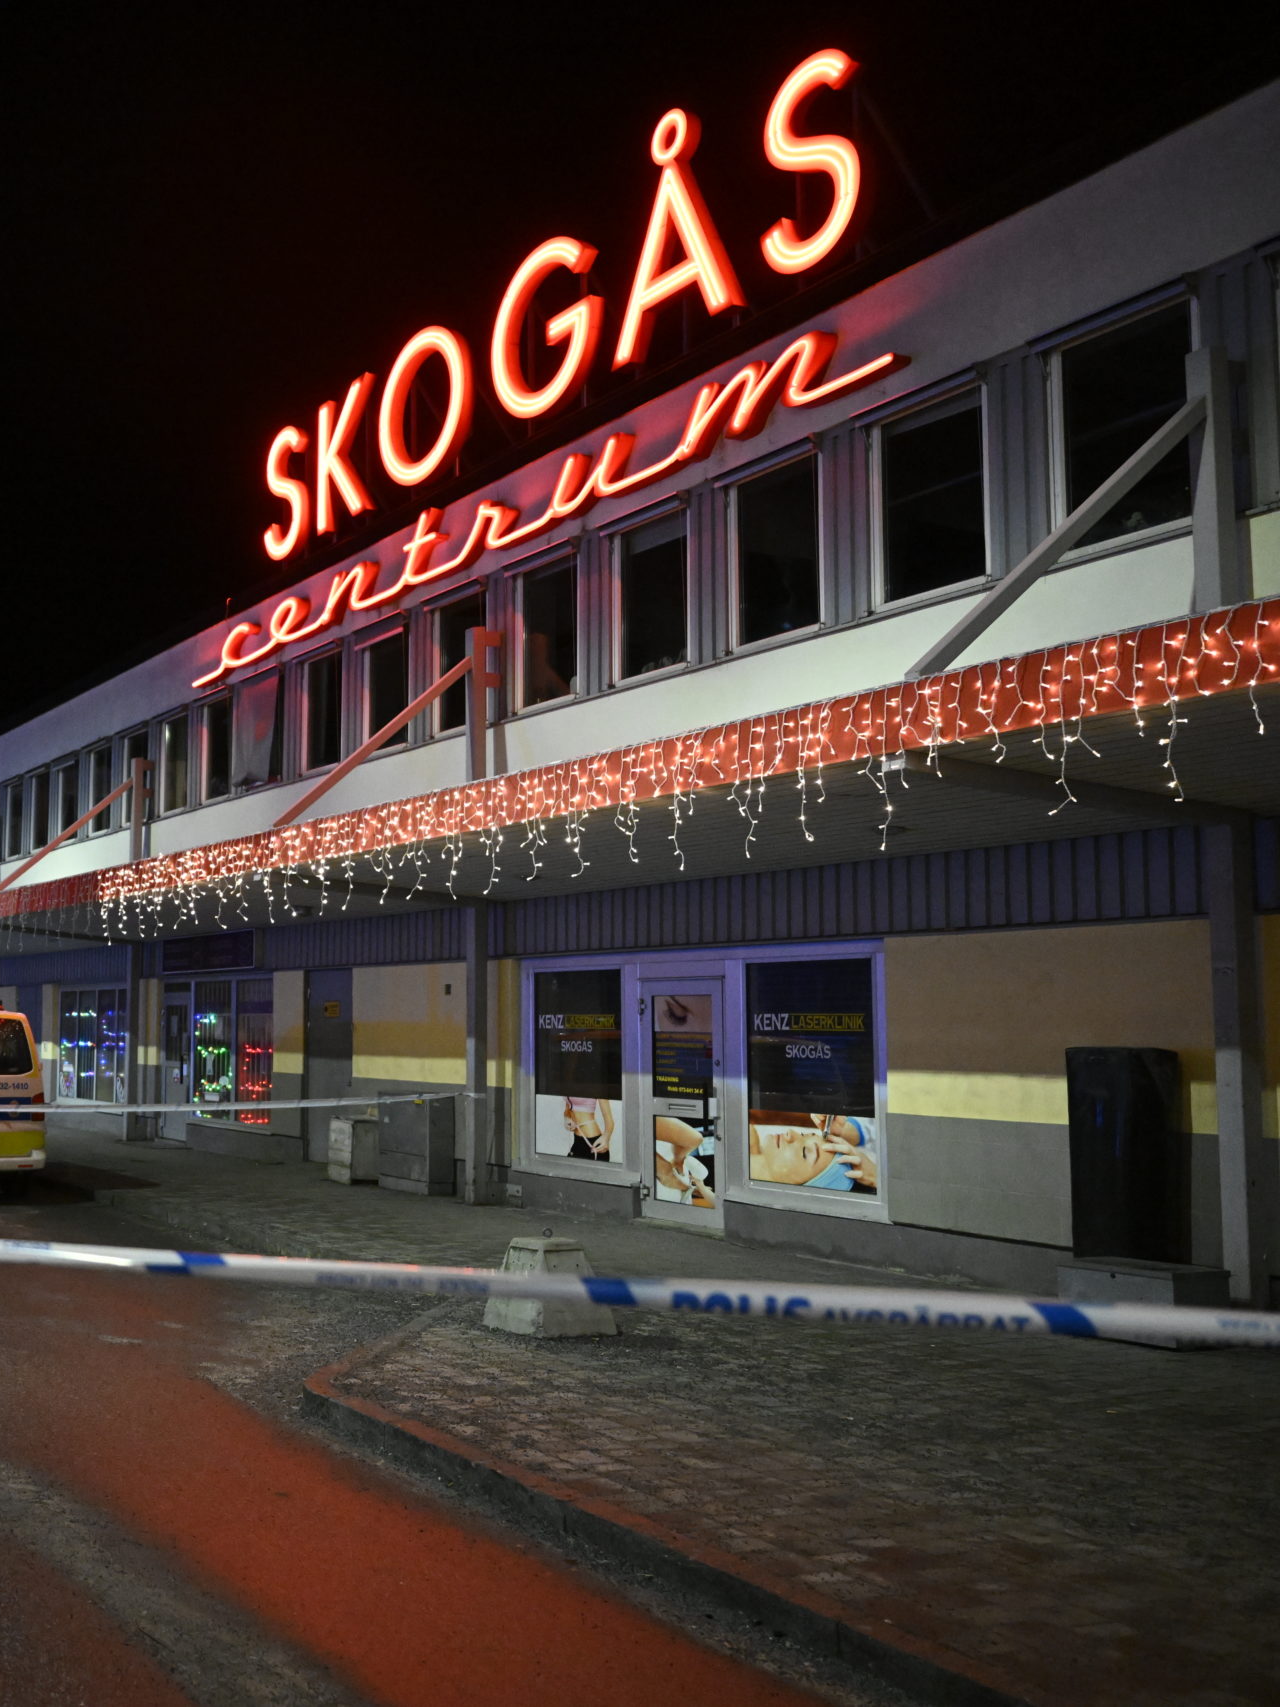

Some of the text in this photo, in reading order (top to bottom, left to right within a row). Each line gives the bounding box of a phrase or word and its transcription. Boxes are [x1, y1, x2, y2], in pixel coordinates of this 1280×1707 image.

[263, 48, 861, 561] SKOGÅS
[192, 331, 911, 688] centrum
[539, 1014, 564, 1029] KENZ
[754, 1013, 864, 1031] KENZ LASERKLINIK
[785, 1042, 831, 1059] SKOGÅS
